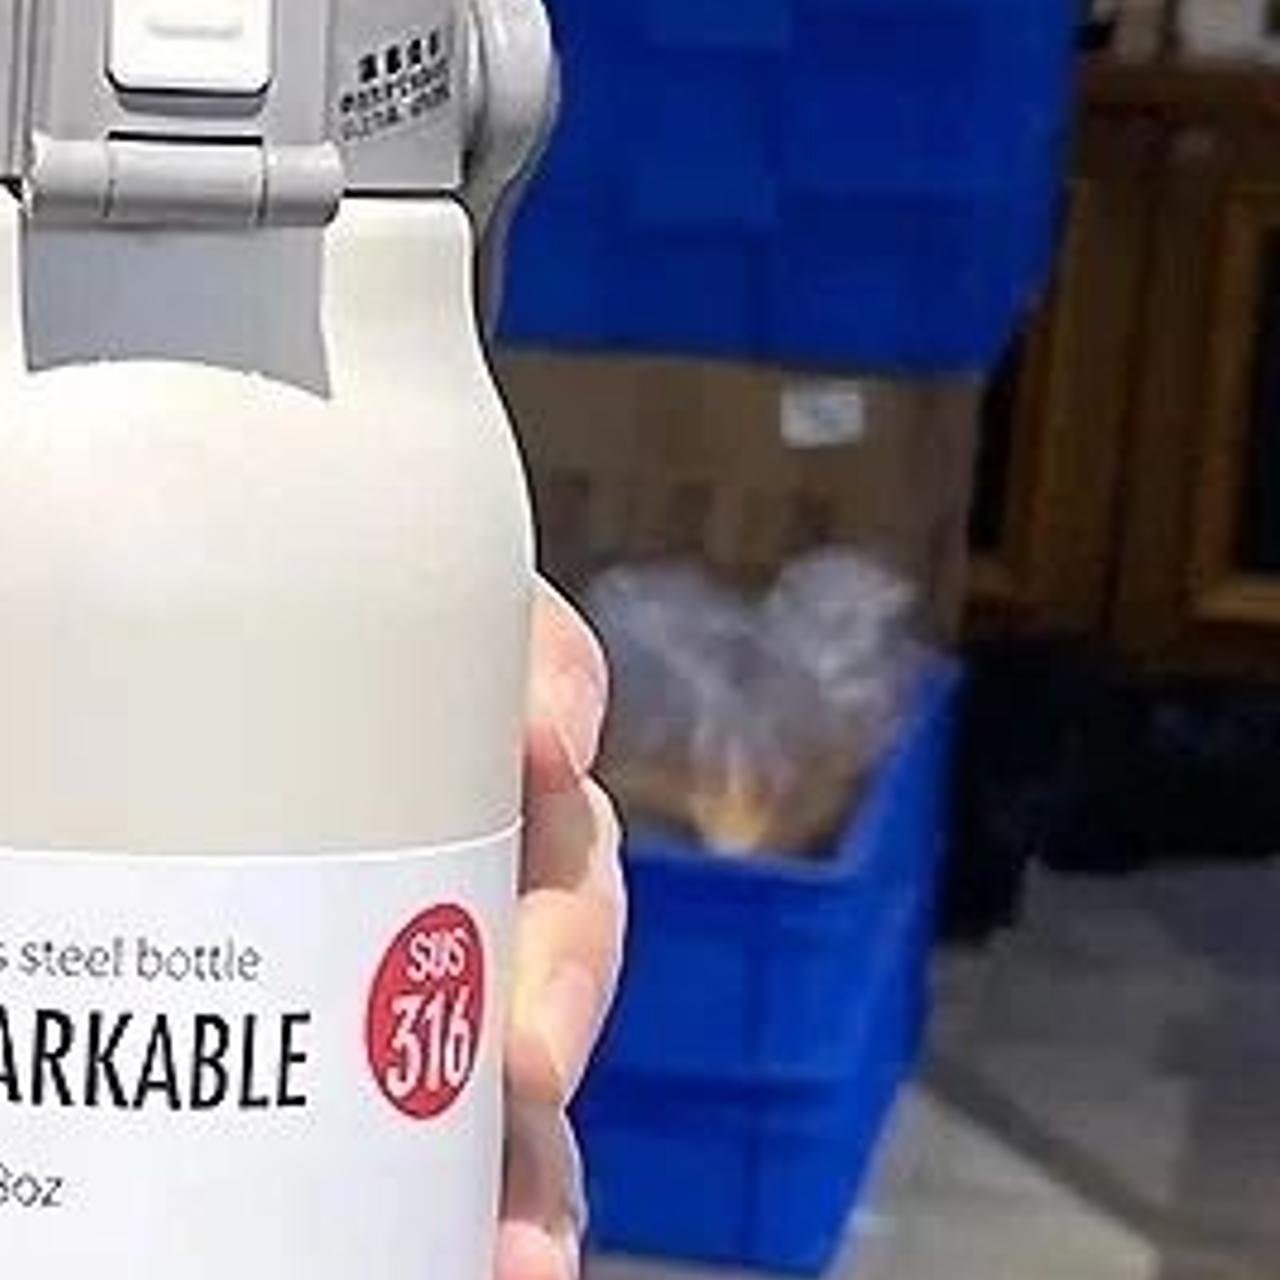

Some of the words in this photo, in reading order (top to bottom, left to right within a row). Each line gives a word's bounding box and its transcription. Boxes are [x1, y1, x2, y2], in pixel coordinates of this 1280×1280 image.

[20, 936, 124, 978] steel
[136, 936, 262, 982] bottle
[386, 985, 471, 1099] 316
